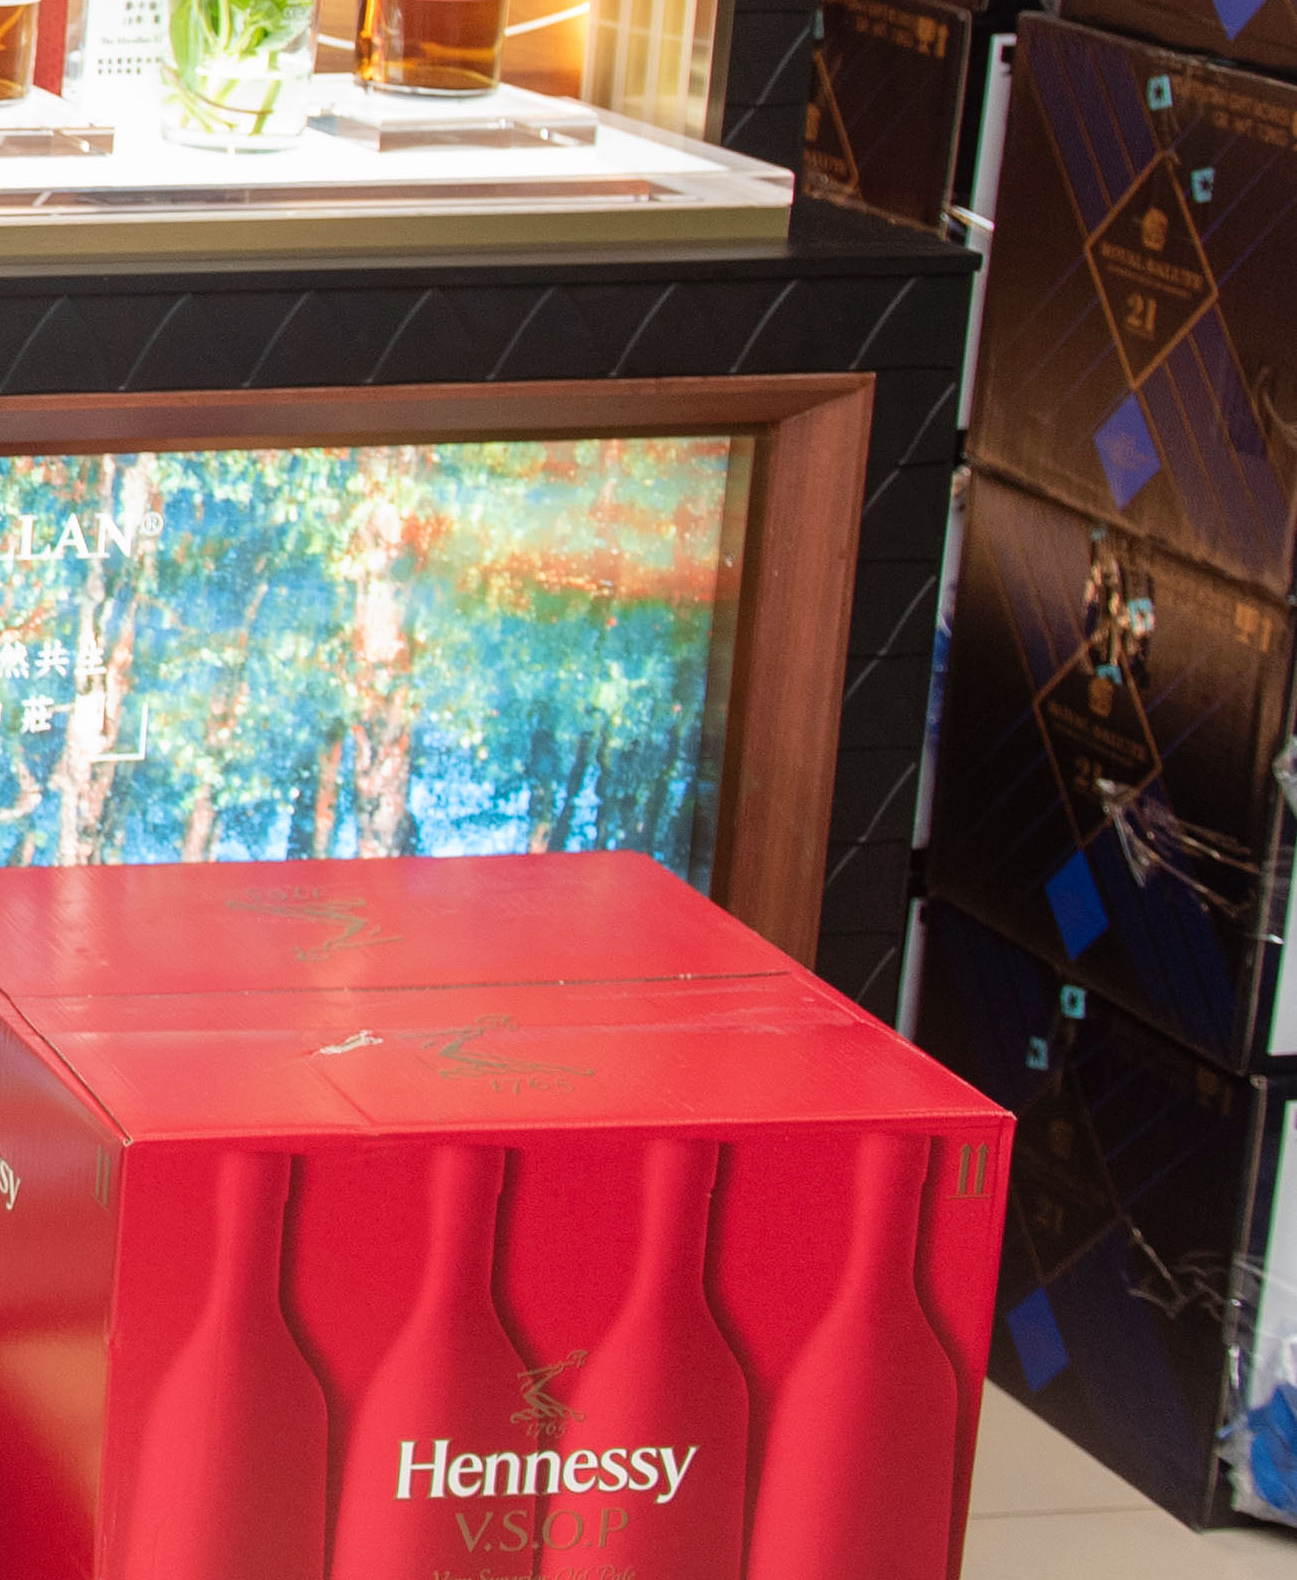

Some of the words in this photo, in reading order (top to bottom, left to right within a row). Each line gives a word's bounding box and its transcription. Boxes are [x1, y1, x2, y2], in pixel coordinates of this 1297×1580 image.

[526, 1421, 567, 1438] 1765
[394, 1438, 701, 1504] Hennessy
[455, 1508, 630, 1553] V.S.O.P
